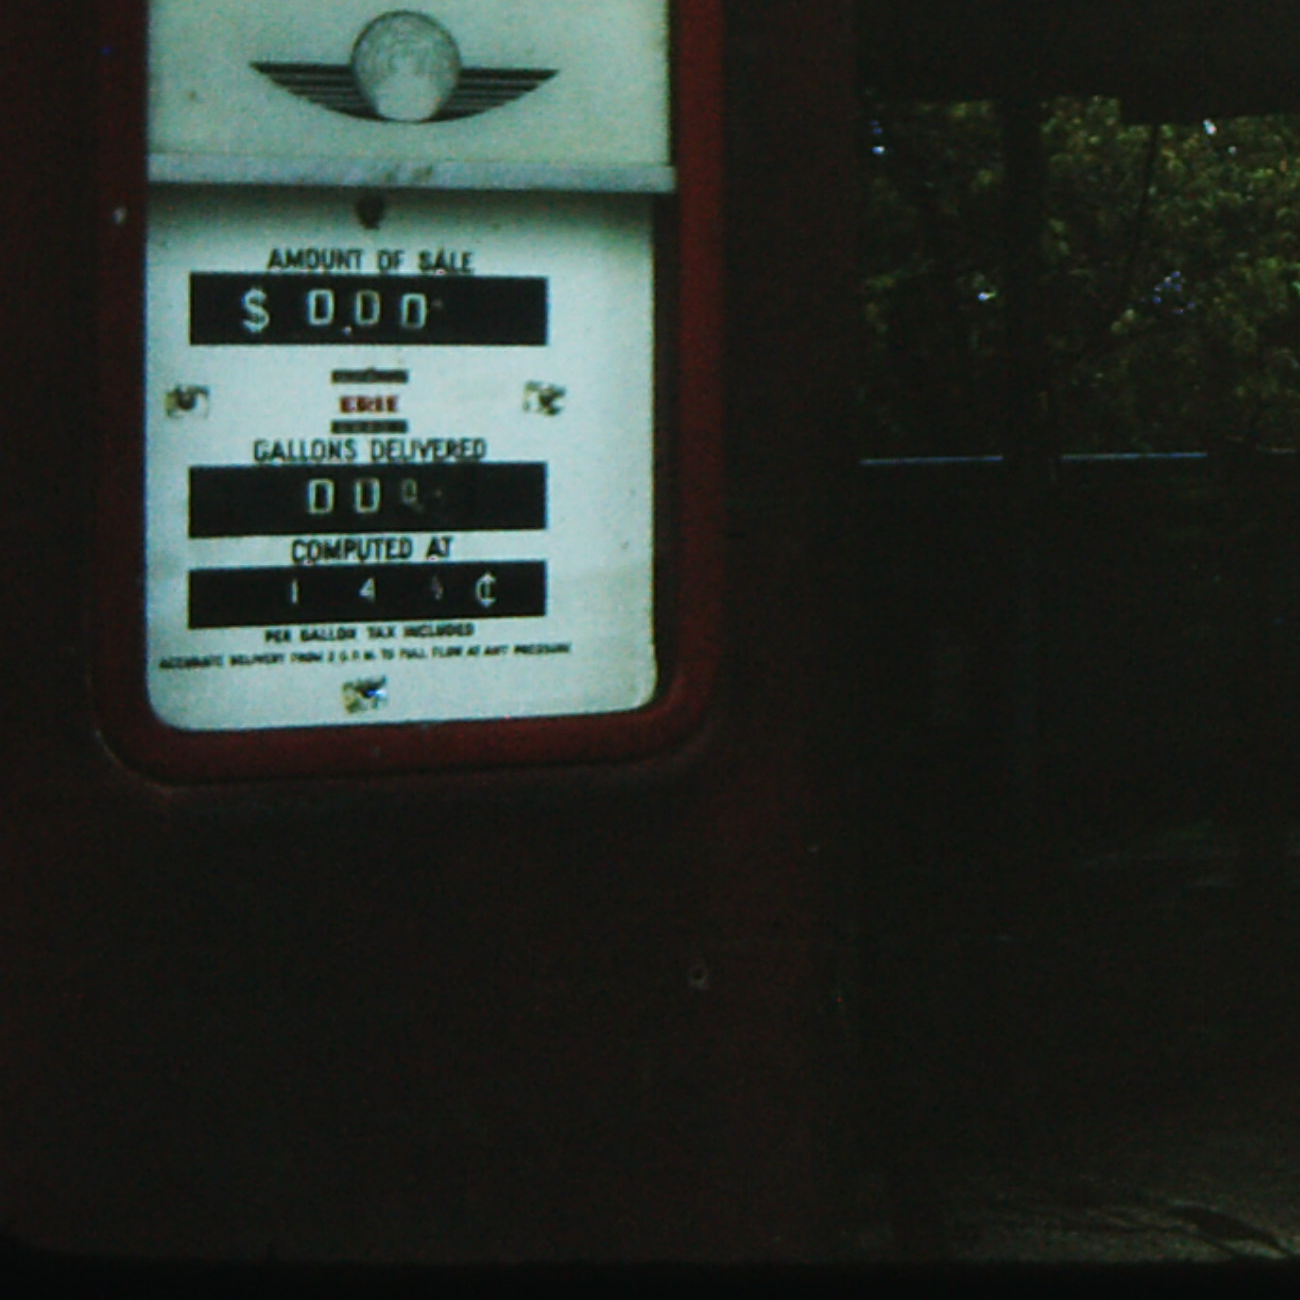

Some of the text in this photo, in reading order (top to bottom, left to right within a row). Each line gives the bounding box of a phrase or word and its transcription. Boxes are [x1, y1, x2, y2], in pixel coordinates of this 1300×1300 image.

[267, 248, 474, 273] AMOUNT OF SALE
[253, 437, 488, 463] GALLONS DELIVERED
[290, 535, 454, 563] COMPUTED AT
[264, 621, 475, 644] PER GALLON TAX INCLUDED
